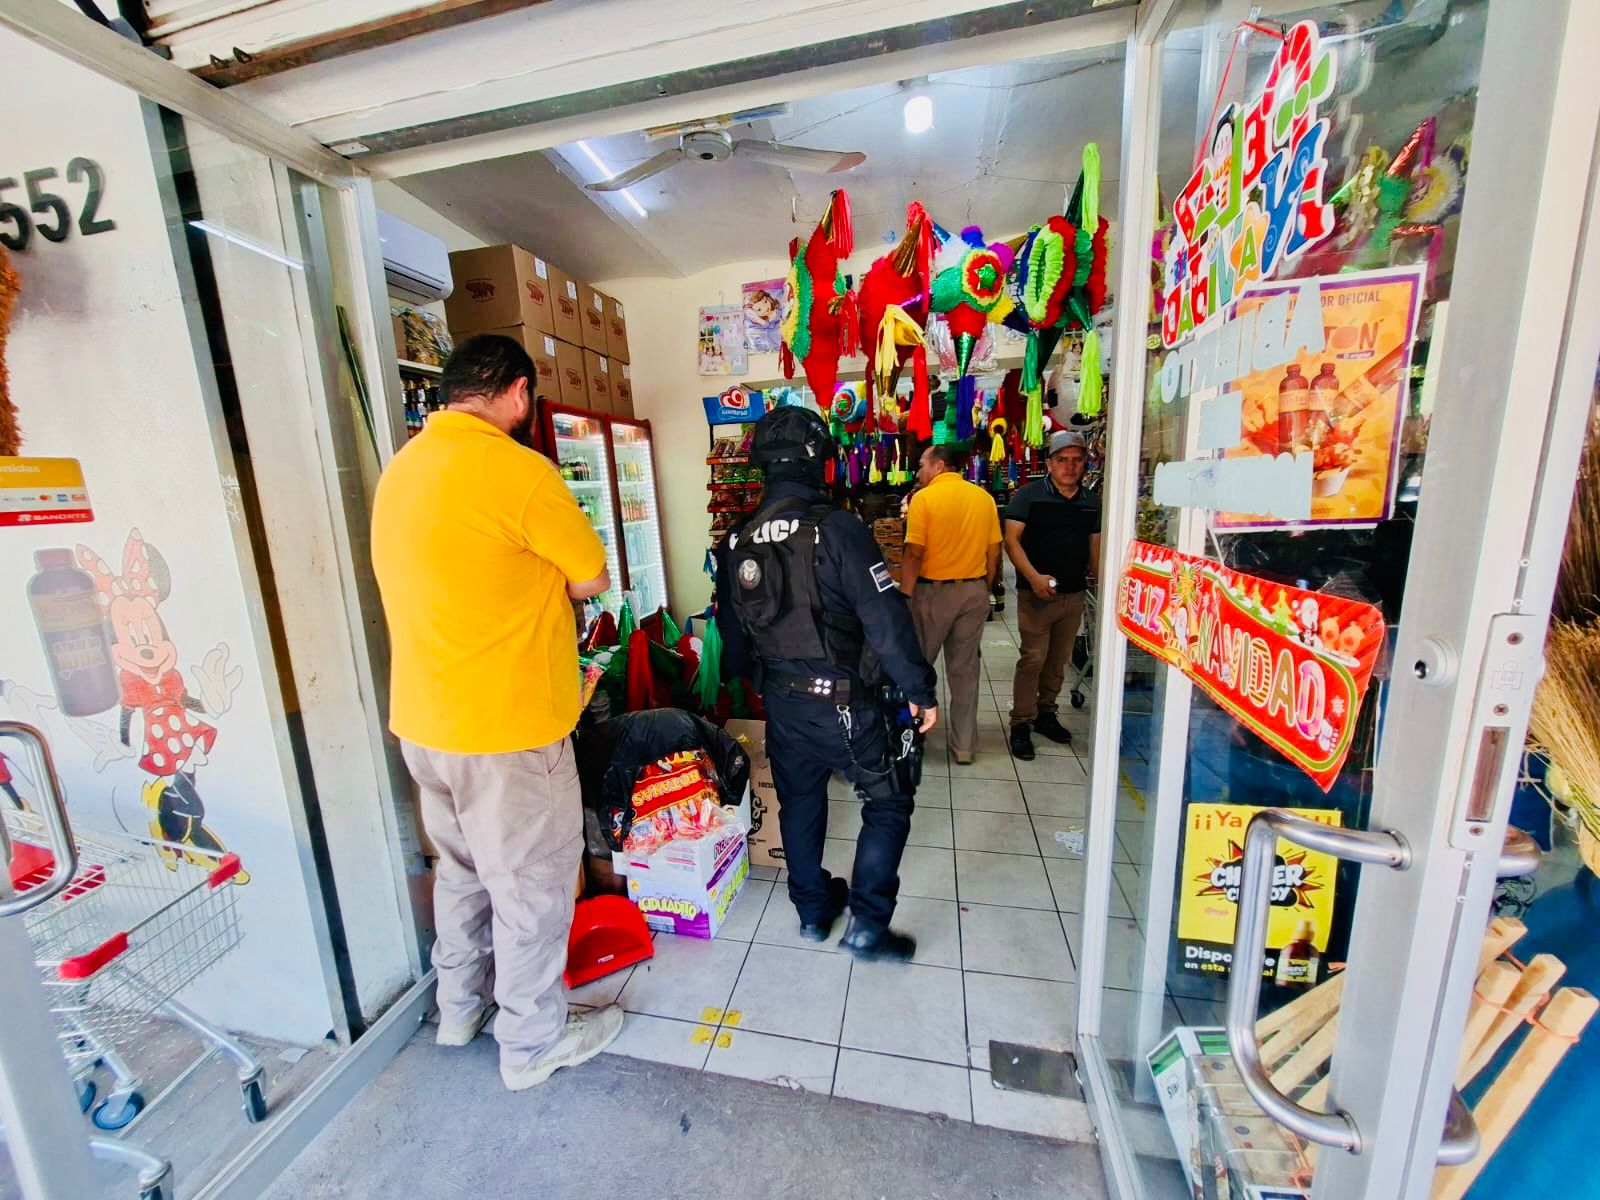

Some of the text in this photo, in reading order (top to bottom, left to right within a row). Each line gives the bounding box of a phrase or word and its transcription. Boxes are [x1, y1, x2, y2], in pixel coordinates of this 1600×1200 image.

[1338, 290, 1382, 304] OFICIAL
[1118, 575, 1326, 741] FELIZ NAVIDAD
[1211, 864, 1303, 887] CHER
[1185, 945, 1276, 967] Dispoe
